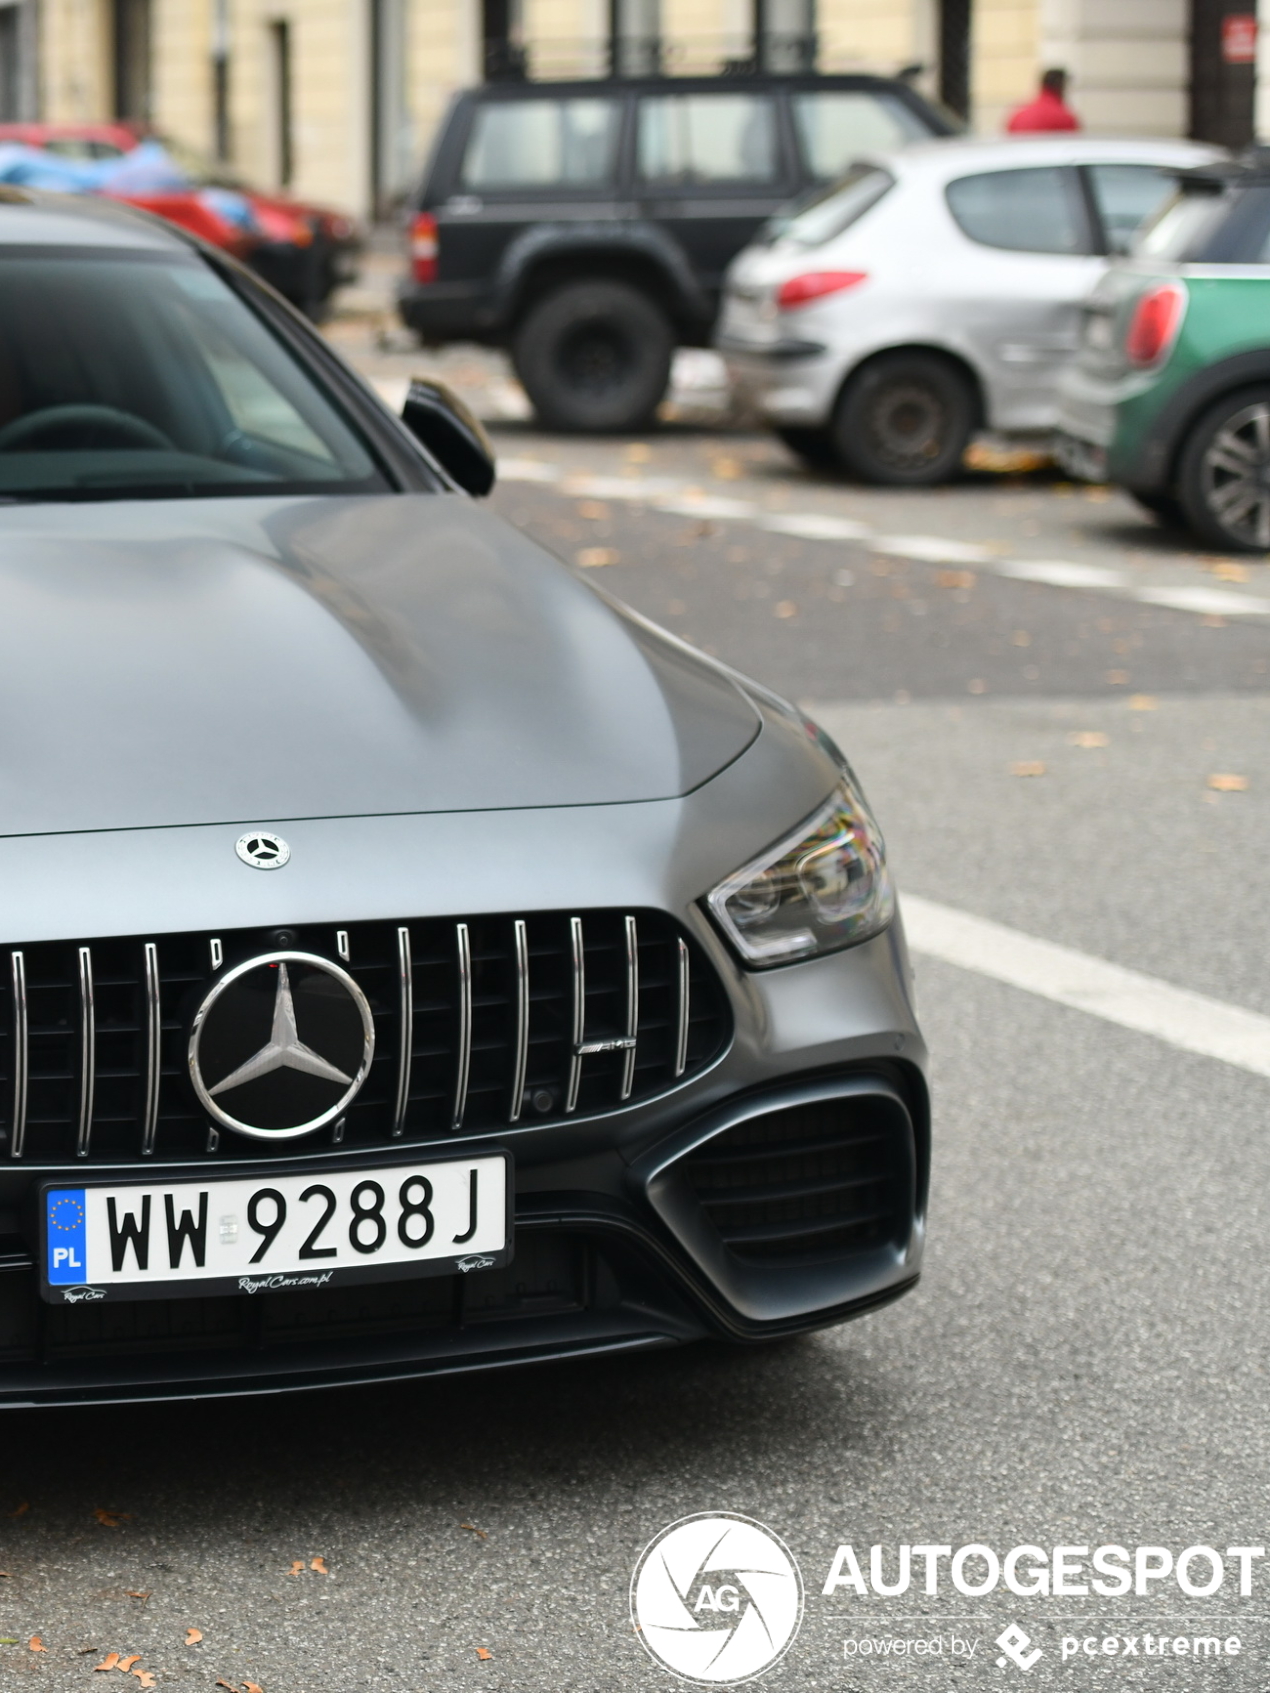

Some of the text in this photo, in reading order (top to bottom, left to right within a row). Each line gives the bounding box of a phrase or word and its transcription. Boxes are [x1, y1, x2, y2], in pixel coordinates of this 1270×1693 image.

[597, 1039, 637, 1051] AMG
[106, 1169, 479, 1272] WW 9288J
[53, 1248, 81, 1269] PL
[458, 1260, 494, 1273] Royal Cars
[64, 1291, 105, 1304] Royal Cars
